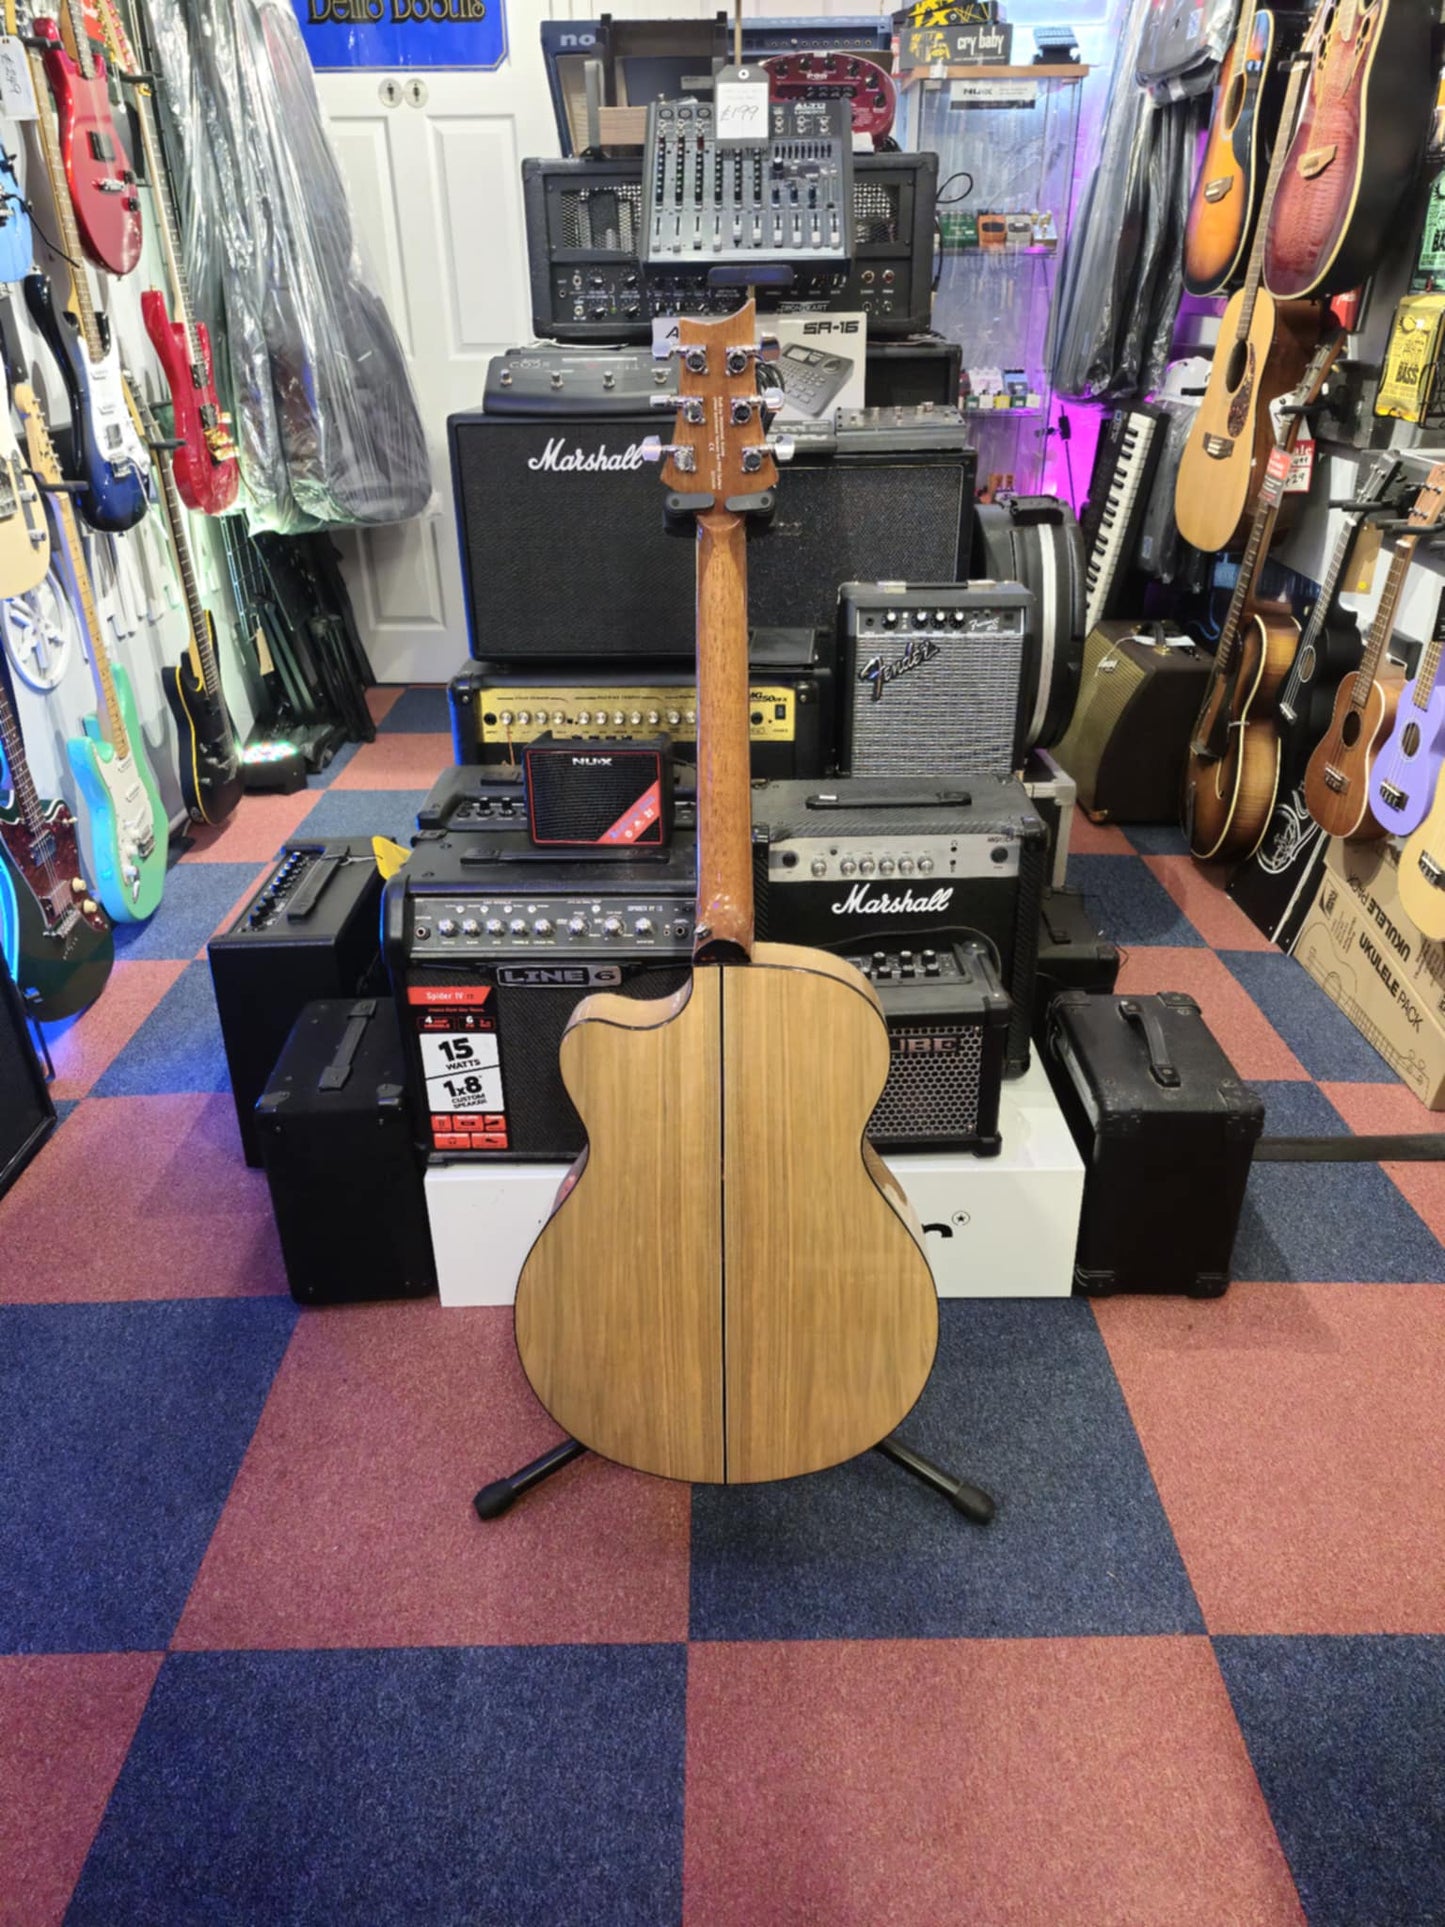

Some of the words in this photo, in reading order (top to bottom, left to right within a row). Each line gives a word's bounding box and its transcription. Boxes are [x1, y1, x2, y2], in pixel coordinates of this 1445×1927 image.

[559, 33, 596, 47] no
[957, 37, 977, 55] cry
[978, 26, 1004, 55] baby
[720, 104, 760, 121] £199
[528, 437, 643, 471] Marshall
[858, 638, 940, 701] Fender
[831, 883, 954, 914] Marshall
[1366, 897, 1411, 962] UKULELE
[504, 970, 586, 983] LINE
[594, 970, 615, 981] 6
[1359, 931, 1400, 998] UKULELE
[1398, 991, 1424, 1033] PACK
[426, 992, 452, 1001] Spider
[438, 1038, 474, 1062] 15
[445, 1059, 481, 1071] WATTS
[451, 1093, 486, 1104] CUSTOM
